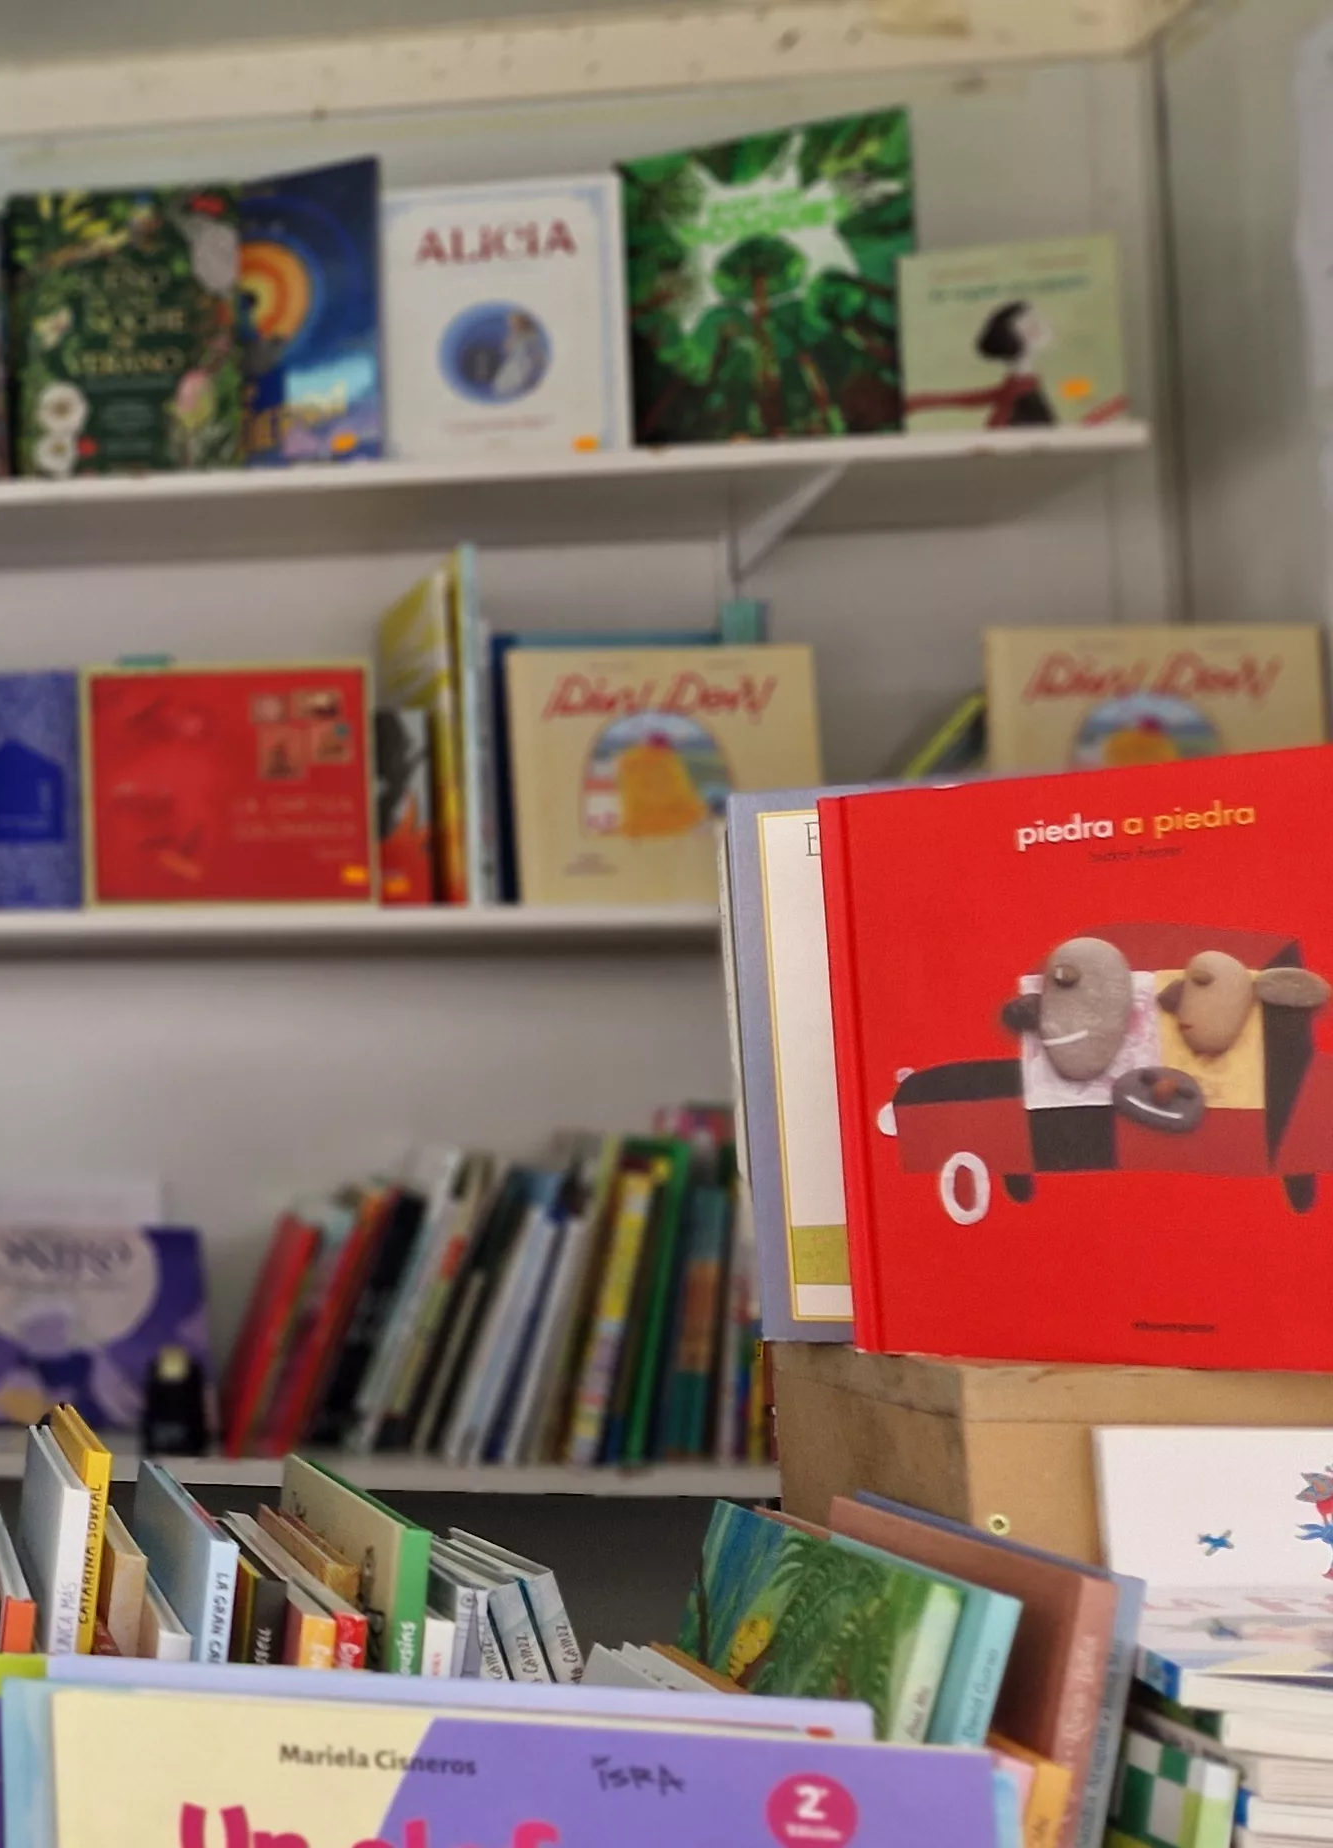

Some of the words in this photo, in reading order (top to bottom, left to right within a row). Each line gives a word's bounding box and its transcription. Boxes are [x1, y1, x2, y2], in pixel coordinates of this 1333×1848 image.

[414, 221, 580, 266] ALICIA
[1016, 812, 1114, 852] piedra
[1121, 816, 1144, 835] a
[1153, 799, 1255, 840] piedra
[78, 1546, 95, 1625] CATARINA
[87, 1483, 102, 1539] SOBRAL
[210, 1595, 227, 1634] GRAN
[278, 1744, 370, 1769] Mariela
[374, 1750, 477, 1776] Cisneros
